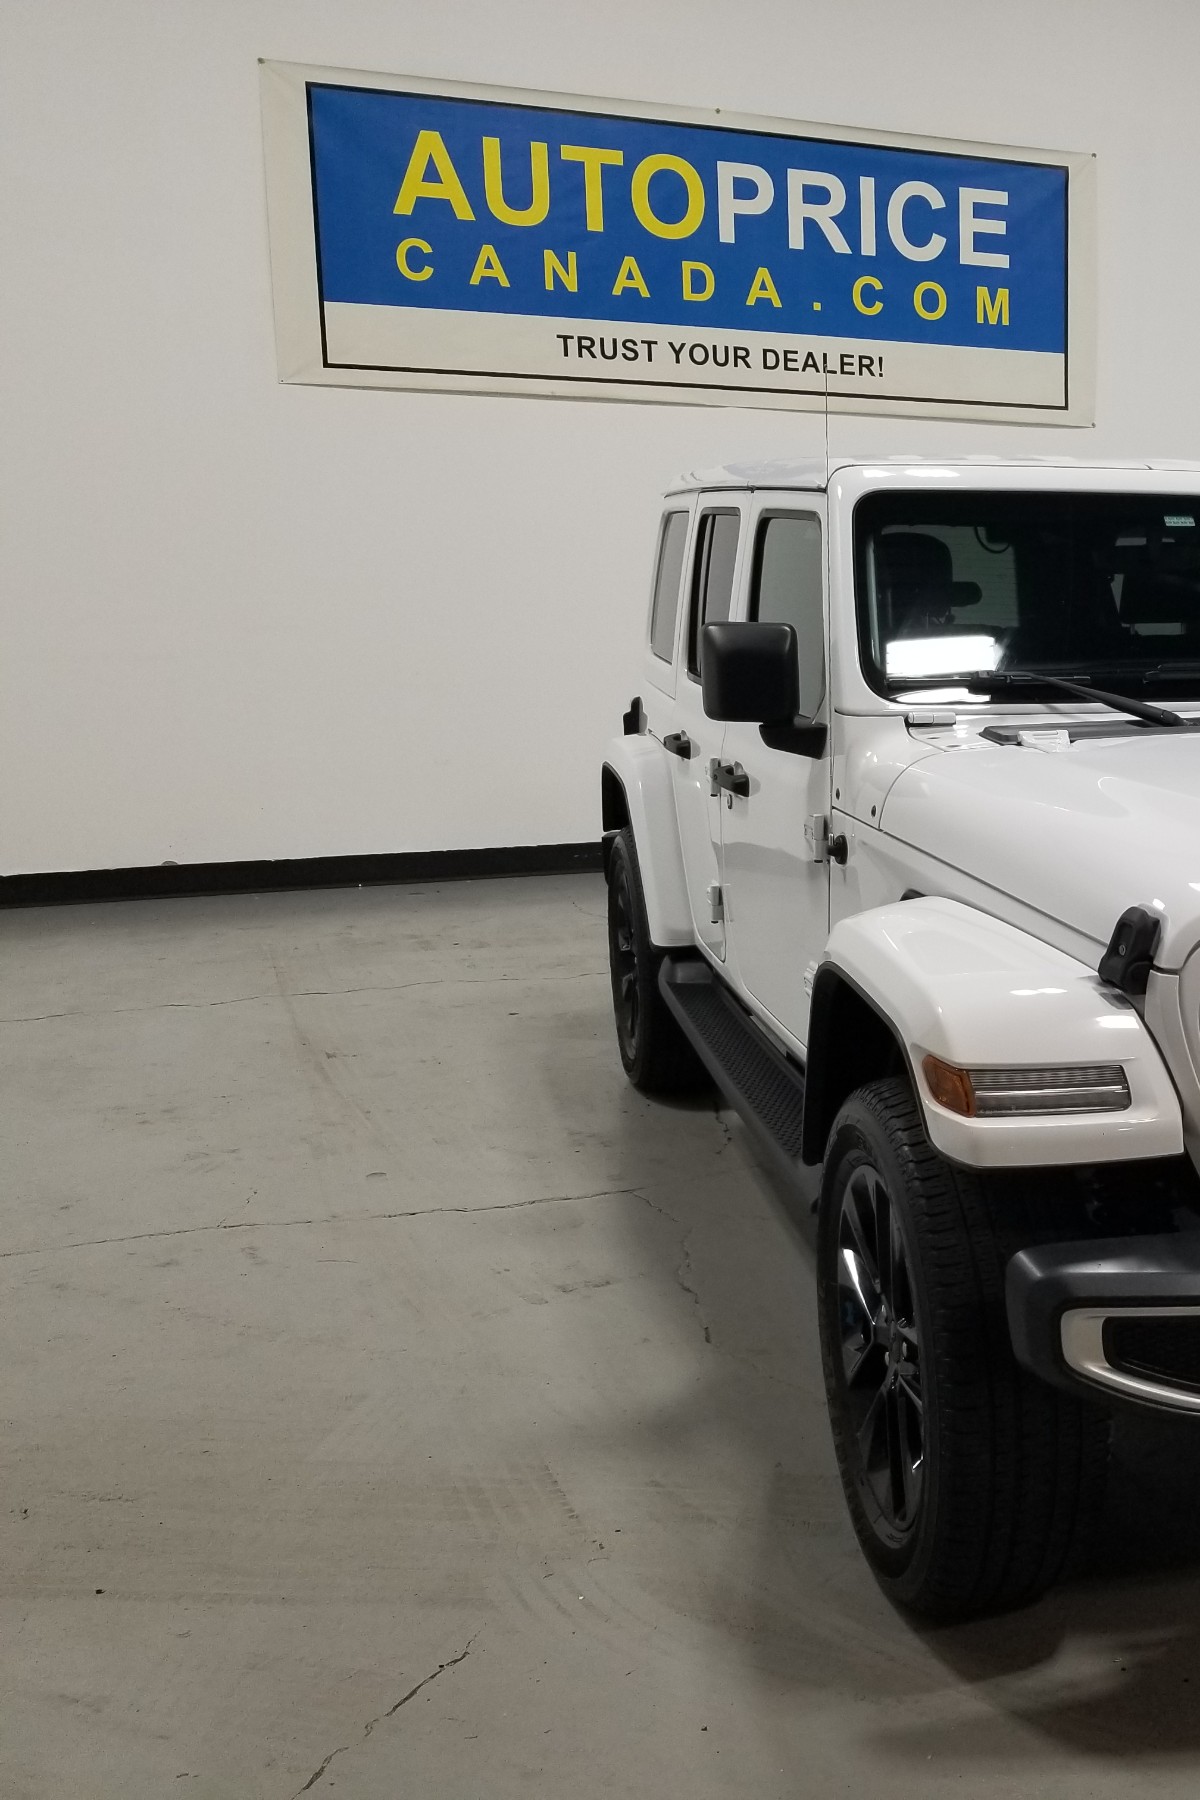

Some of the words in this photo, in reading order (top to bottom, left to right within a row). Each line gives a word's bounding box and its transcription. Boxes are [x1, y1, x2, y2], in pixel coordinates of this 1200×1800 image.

[392, 129, 1010, 269] AUTOPRICE
[396, 237, 1010, 326] CANADA.COM
[556, 334, 658, 363] TRUST
[667, 341, 752, 369] YOUR
[762, 348, 884, 378] DEALER!
